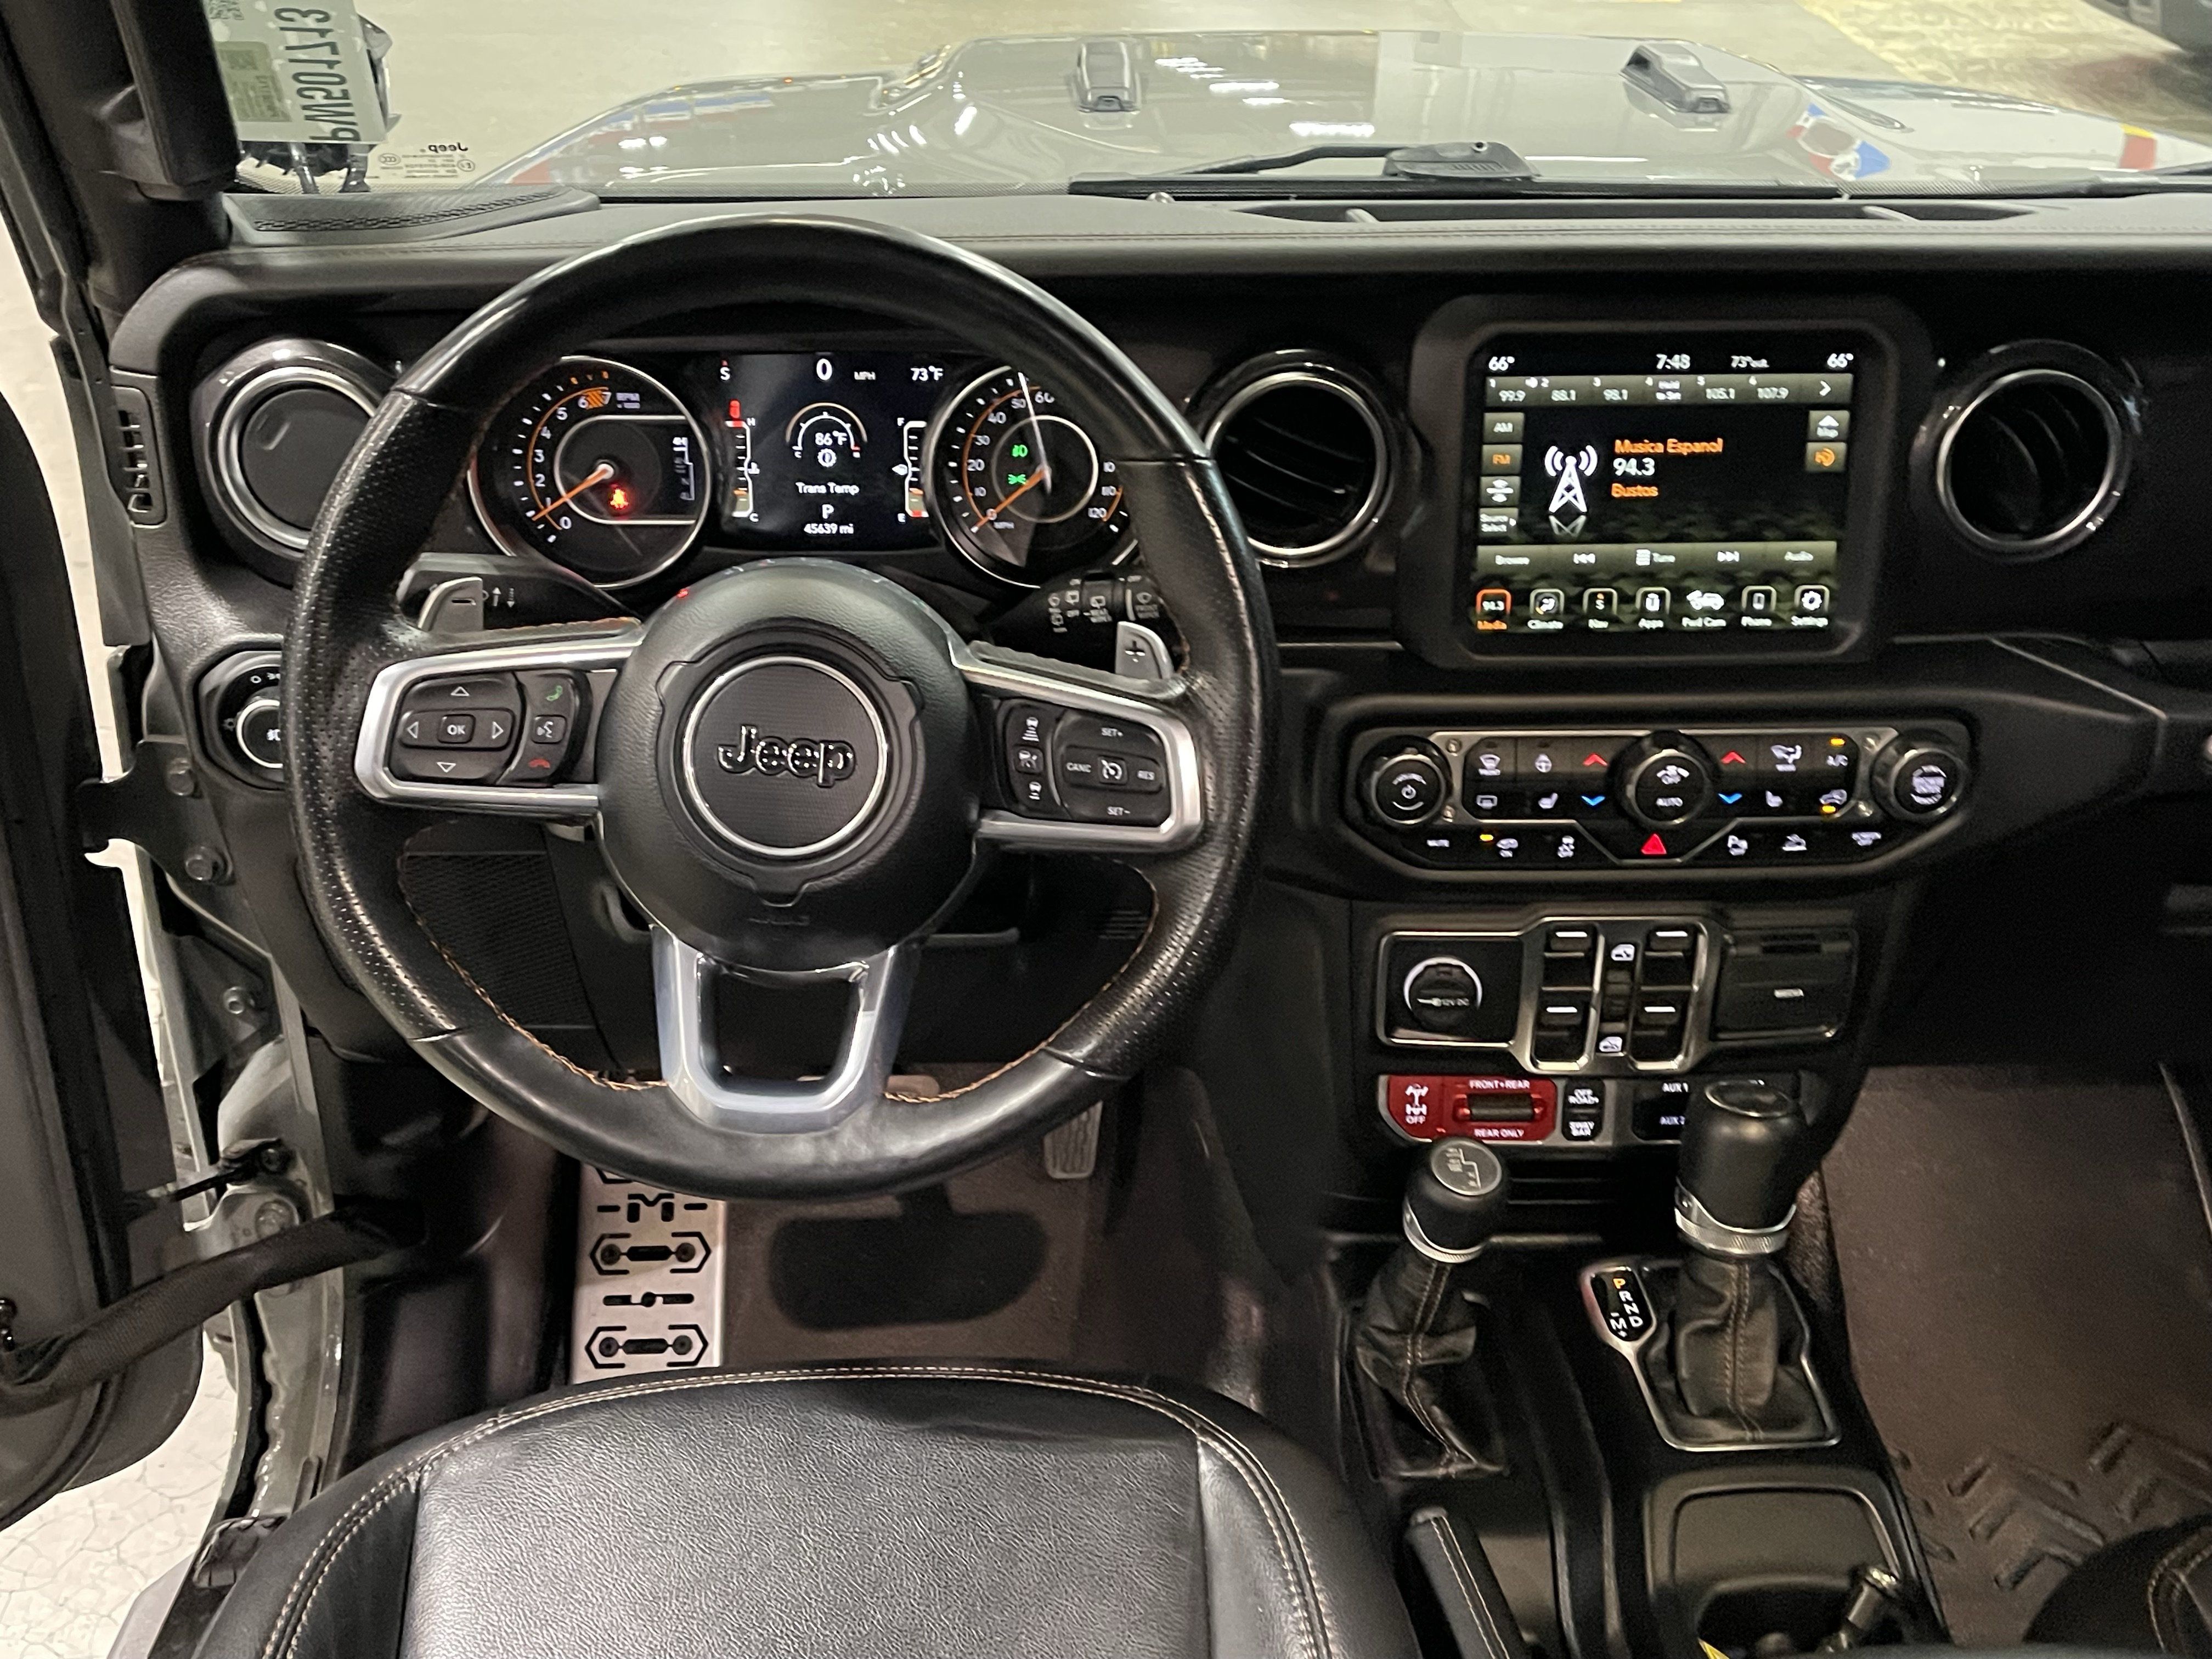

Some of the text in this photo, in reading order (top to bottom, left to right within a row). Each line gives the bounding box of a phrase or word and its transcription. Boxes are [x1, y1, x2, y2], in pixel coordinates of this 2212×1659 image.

[1656, 353, 1690, 370] 7:48
[720, 367, 731, 380] S
[816, 358, 832, 380] 0
[910, 366, 944, 381] 73°F
[578, 396, 589, 408] 6
[556, 407, 568, 420] 5
[1615, 439, 1664, 454] Musica
[534, 450, 544, 462] 3
[967, 459, 985, 471] 20
[1613, 458, 1655, 476] 94.3
[535, 474, 545, 487] 2
[795, 482, 860, 495] Trans Temp
[822, 504, 834, 518] P
[560, 516, 571, 529] 0
[839, 524, 854, 534] mi
[447, 725, 465, 735] OK
[718, 725, 856, 788] Jeep
[1406, 1116, 1426, 1124] OFF
[1474, 1128, 1524, 1138] REAR ONLY
[1613, 1278, 1626, 1289] P
[1619, 1291, 1633, 1302] R
[1624, 1302, 1639, 1314] N
[1610, 1317, 1628, 1330] M
[1629, 1316, 1643, 1327] D
